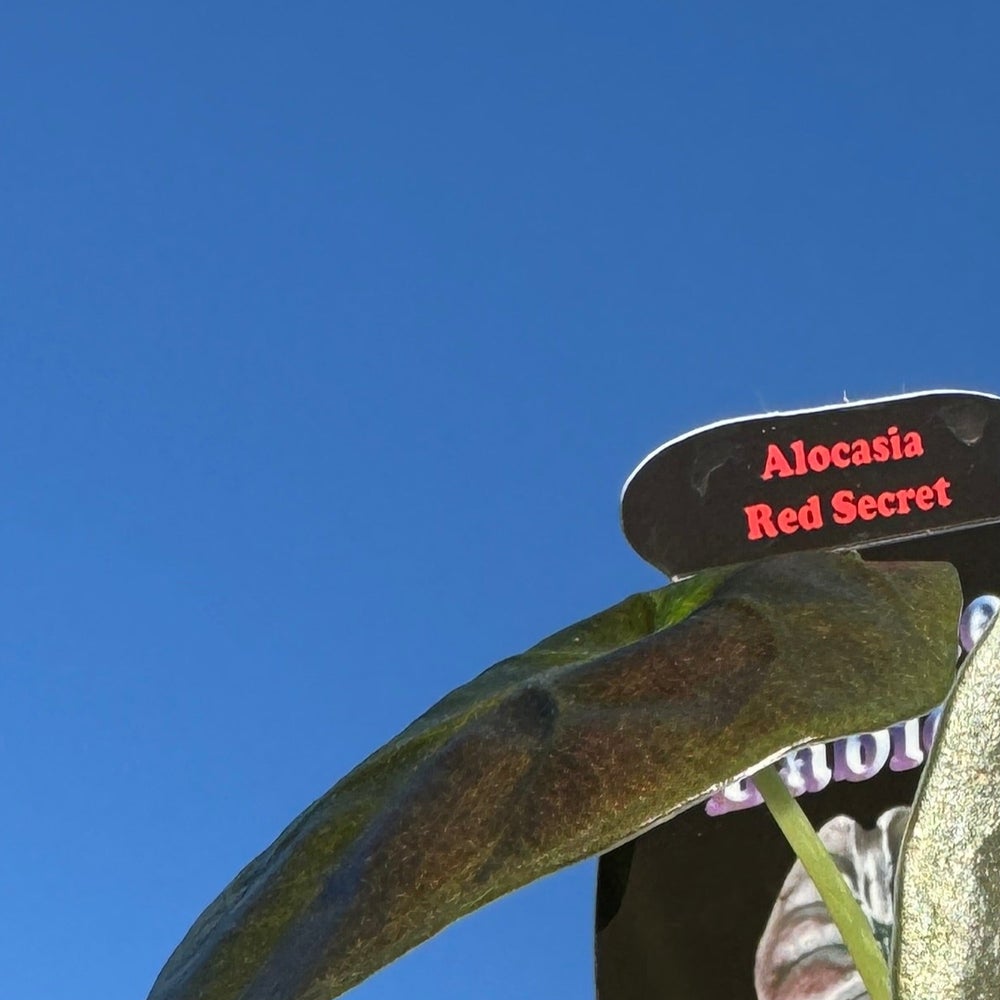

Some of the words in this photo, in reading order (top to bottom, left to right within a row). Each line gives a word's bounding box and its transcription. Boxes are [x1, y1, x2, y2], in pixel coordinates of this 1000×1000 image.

[760, 426, 924, 481] Alocasia
[744, 494, 824, 540] Red
[831, 477, 953, 524] Secret
